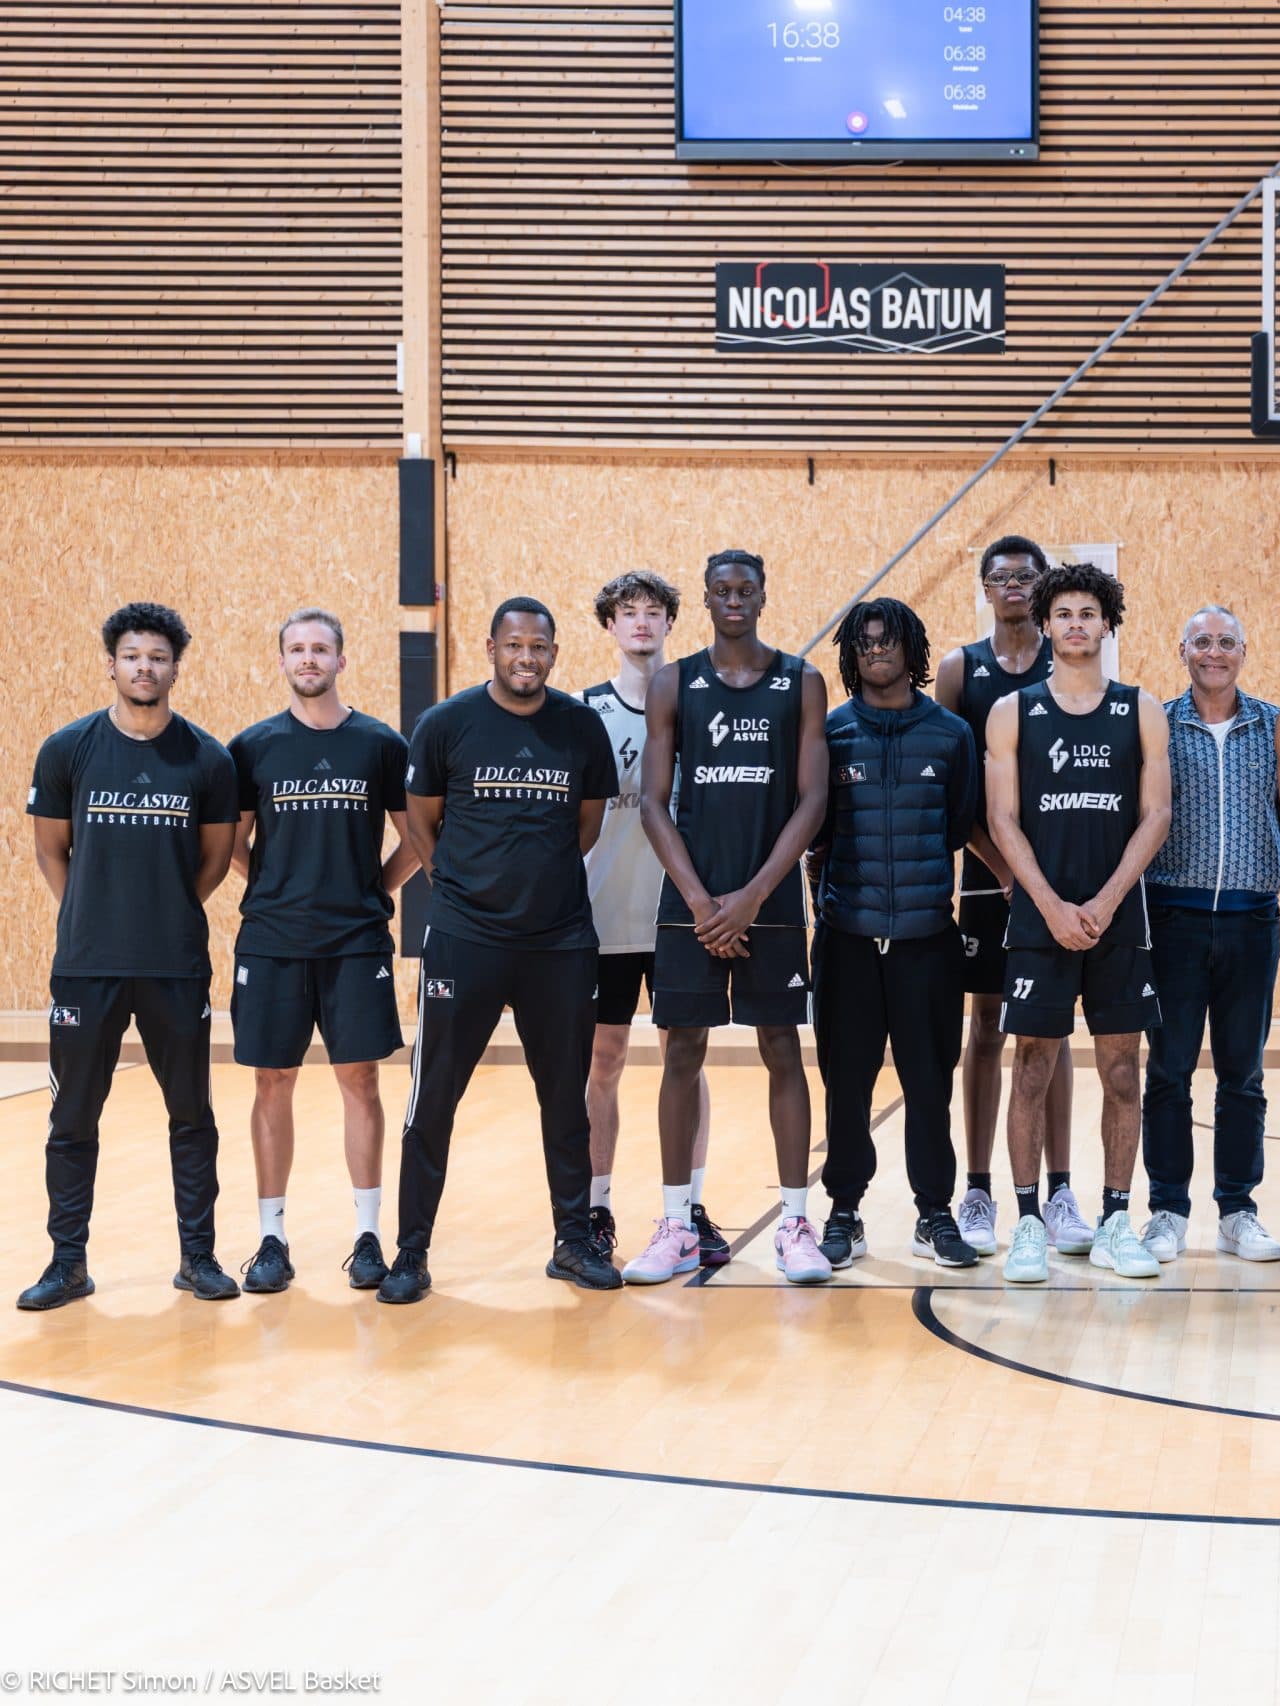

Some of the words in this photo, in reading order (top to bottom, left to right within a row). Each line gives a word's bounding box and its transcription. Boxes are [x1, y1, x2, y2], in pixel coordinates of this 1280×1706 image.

[943, 7, 986, 23] 04:38
[767, 22, 840, 49] 16:38
[943, 46, 986, 62] 06:38
[943, 85, 986, 101] 06:38
[728, 287, 871, 330] NICOLAS
[882, 287, 992, 330] BATUM
[769, 676, 791, 691] 23
[1109, 702, 1130, 716] 10
[733, 718, 770, 731] LDLC
[733, 732, 769, 742] ASVEL
[1073, 744, 1111, 757] LDLC
[1073, 758, 1111, 768] ASVEL
[474, 766, 520, 782] LDLC
[521, 768, 570, 786] ASVEL
[694, 765, 776, 784] SKWEEK
[272, 779, 317, 796] LDLC
[318, 778, 368, 795] ASVEL
[88, 791, 136, 807] LDLC
[137, 793, 190, 811] ASVEL
[473, 789, 568, 803] BASKETBALL
[1039, 792, 1123, 812] SKWEEK
[274, 800, 368, 812] BASKETBALL
[87, 814, 188, 828] BASKETBALL
